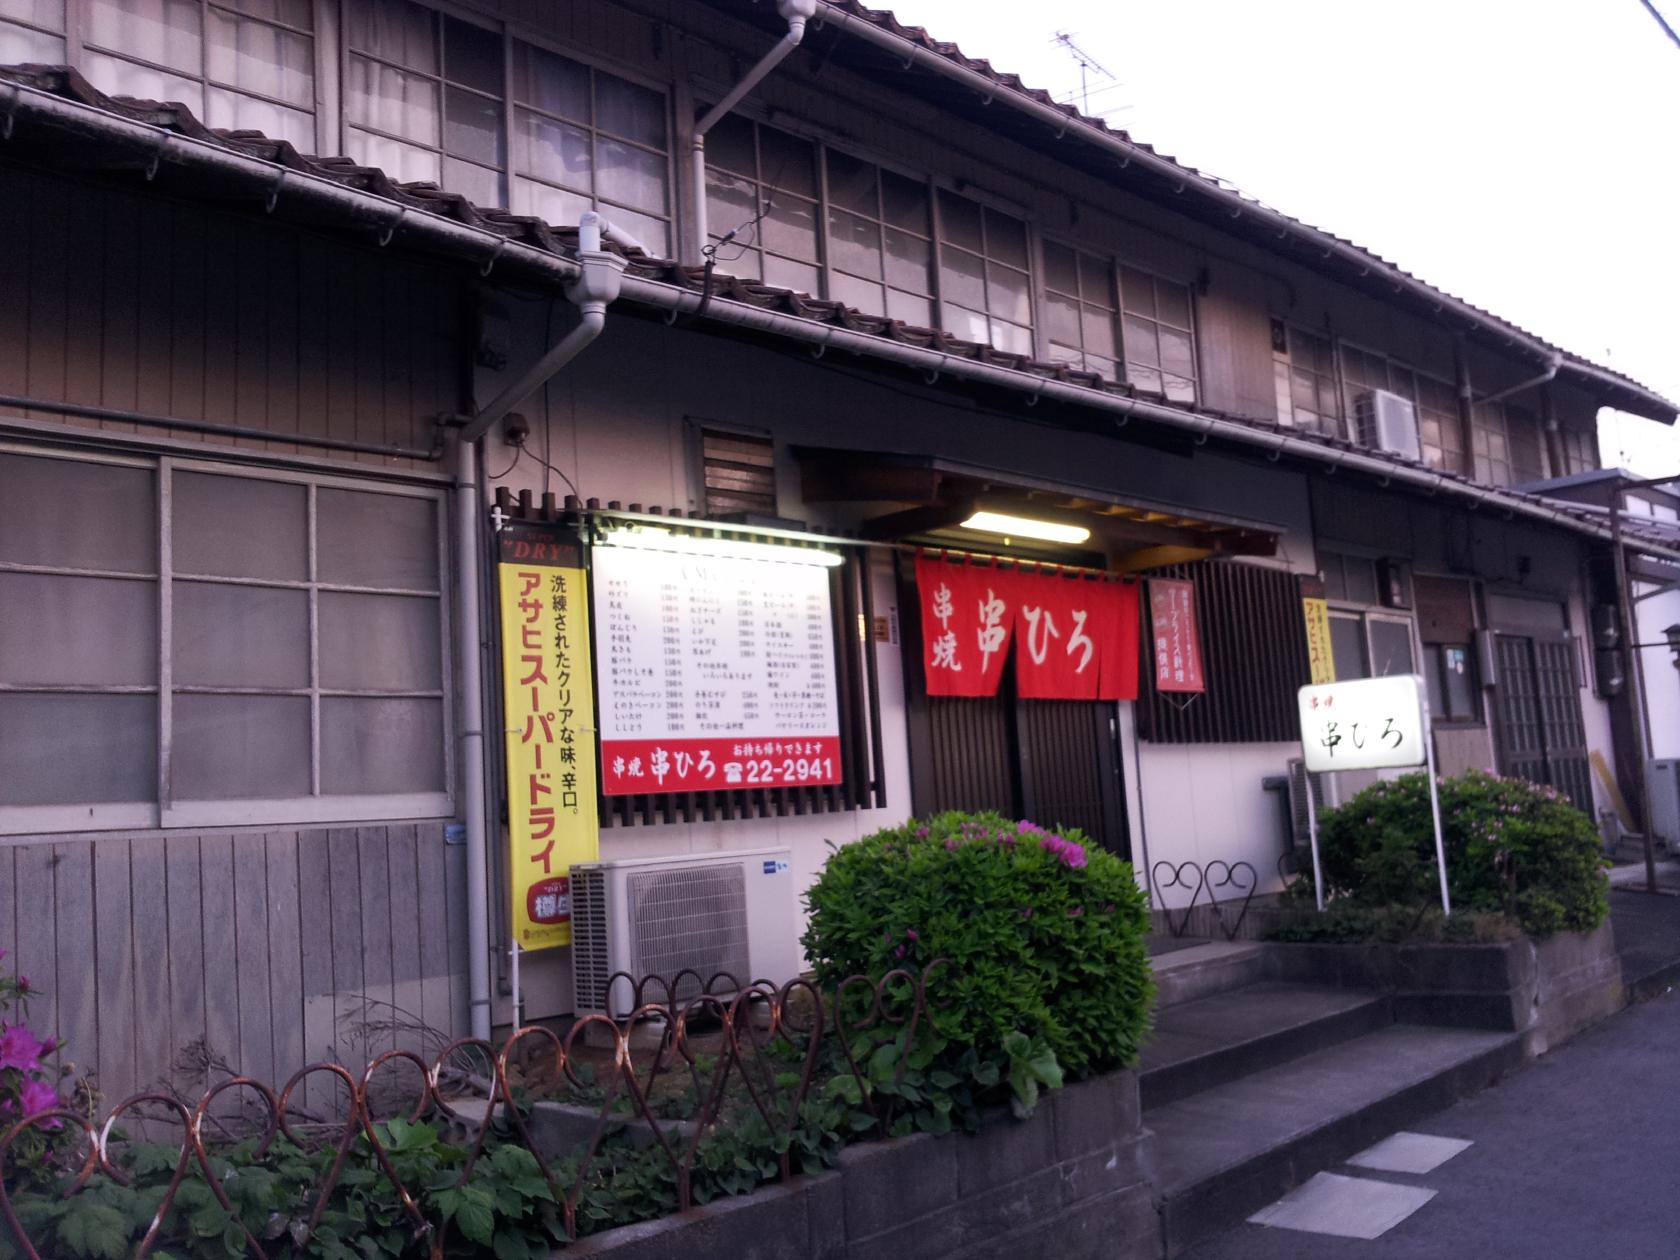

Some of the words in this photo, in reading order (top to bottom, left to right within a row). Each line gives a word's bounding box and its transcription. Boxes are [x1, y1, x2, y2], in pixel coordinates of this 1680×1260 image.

[931, 582, 962, 671] 串焼
[977, 588, 1094, 674] 串ひろ
[518, 572, 556, 873] アサヒスーパードライ
[549, 575, 578, 815] 洗練されたクリアな味、辛口。
[613, 755, 644, 779] 串焼
[651, 747, 716, 785] 串ひろ
[733, 742, 823, 757] お持ち帰りできます
[1320, 718, 1404, 758] 串ひろ
[747, 758, 834, 783] 22-2941
